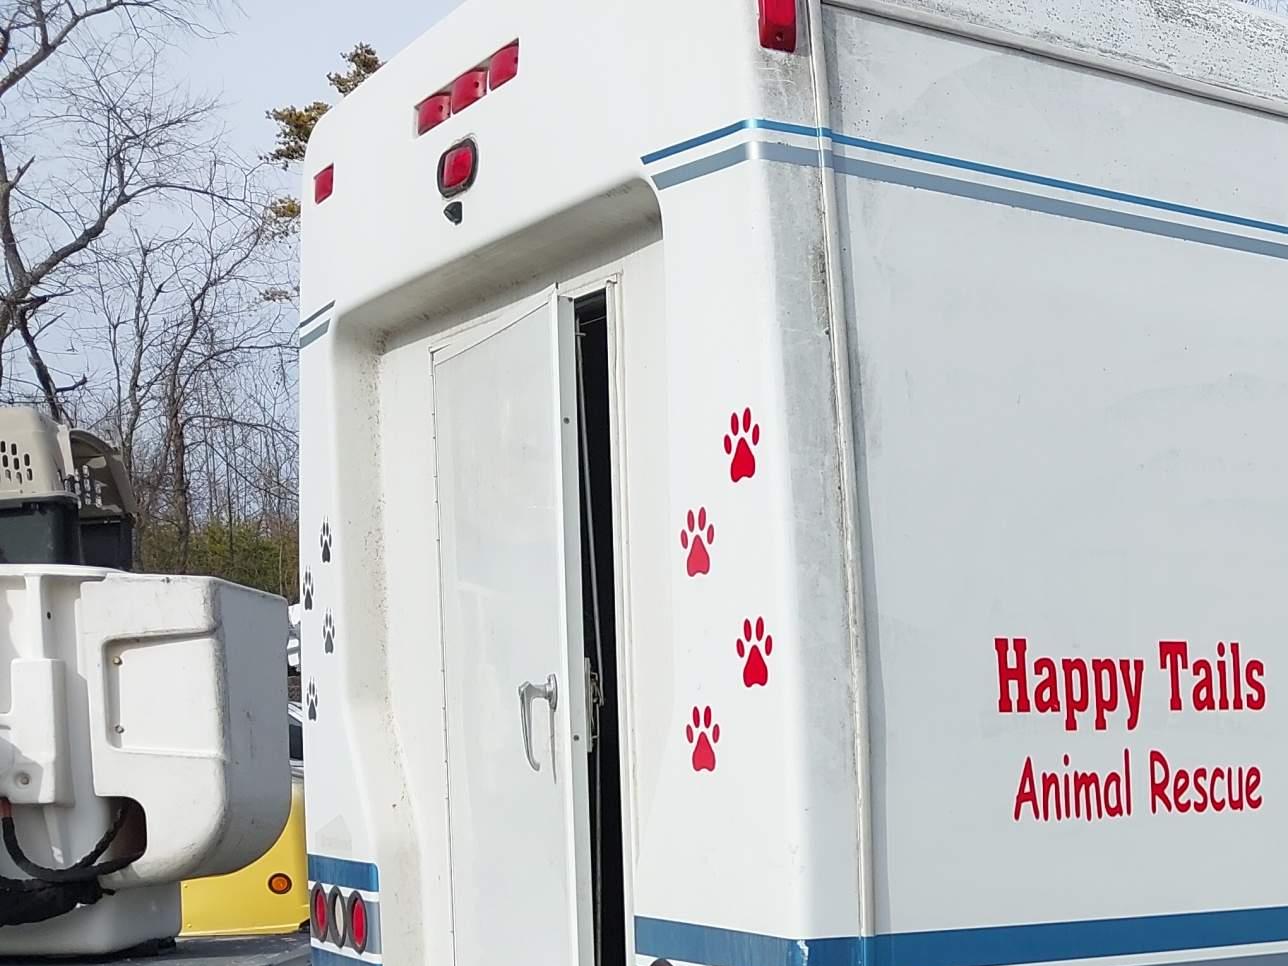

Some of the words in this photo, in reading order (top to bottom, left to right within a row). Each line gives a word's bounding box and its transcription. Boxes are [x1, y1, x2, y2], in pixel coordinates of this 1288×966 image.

[994, 637, 1145, 731] Happy
[1158, 640, 1267, 711] Tails
[1013, 748, 1133, 821] Animal
[1149, 749, 1263, 814] Rescue
